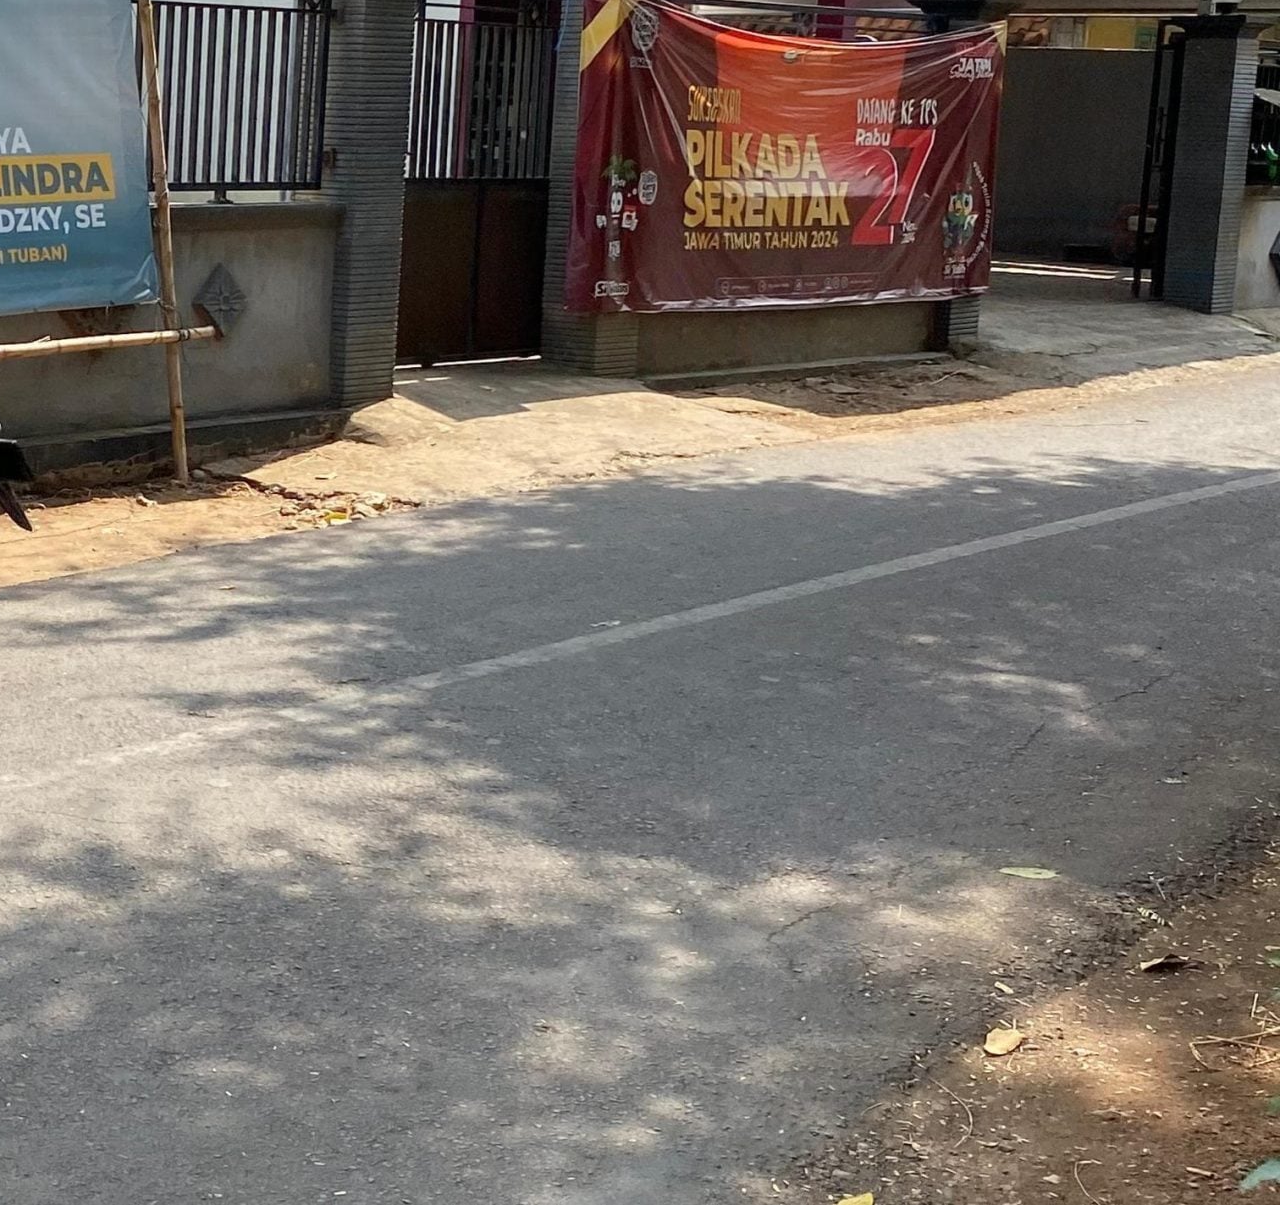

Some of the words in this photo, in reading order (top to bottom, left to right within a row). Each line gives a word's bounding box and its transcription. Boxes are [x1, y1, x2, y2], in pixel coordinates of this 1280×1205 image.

[856, 97, 896, 125] DATANG
[900, 98, 915, 125] KE
[920, 98, 938, 126] TPS
[855, 127, 891, 147] Rabu
[685, 129, 827, 180] PILKADA
[851, 128, 936, 245] 27
[75, 203, 107, 229] SE
[683, 178, 851, 228] SERENTAK
[683, 231, 719, 250] JAWA
[723, 231, 761, 250] TIMUR
[764, 231, 809, 249] TAHUN
[810, 230, 839, 248] 2024
[7, 243, 68, 266] TUBAN)
